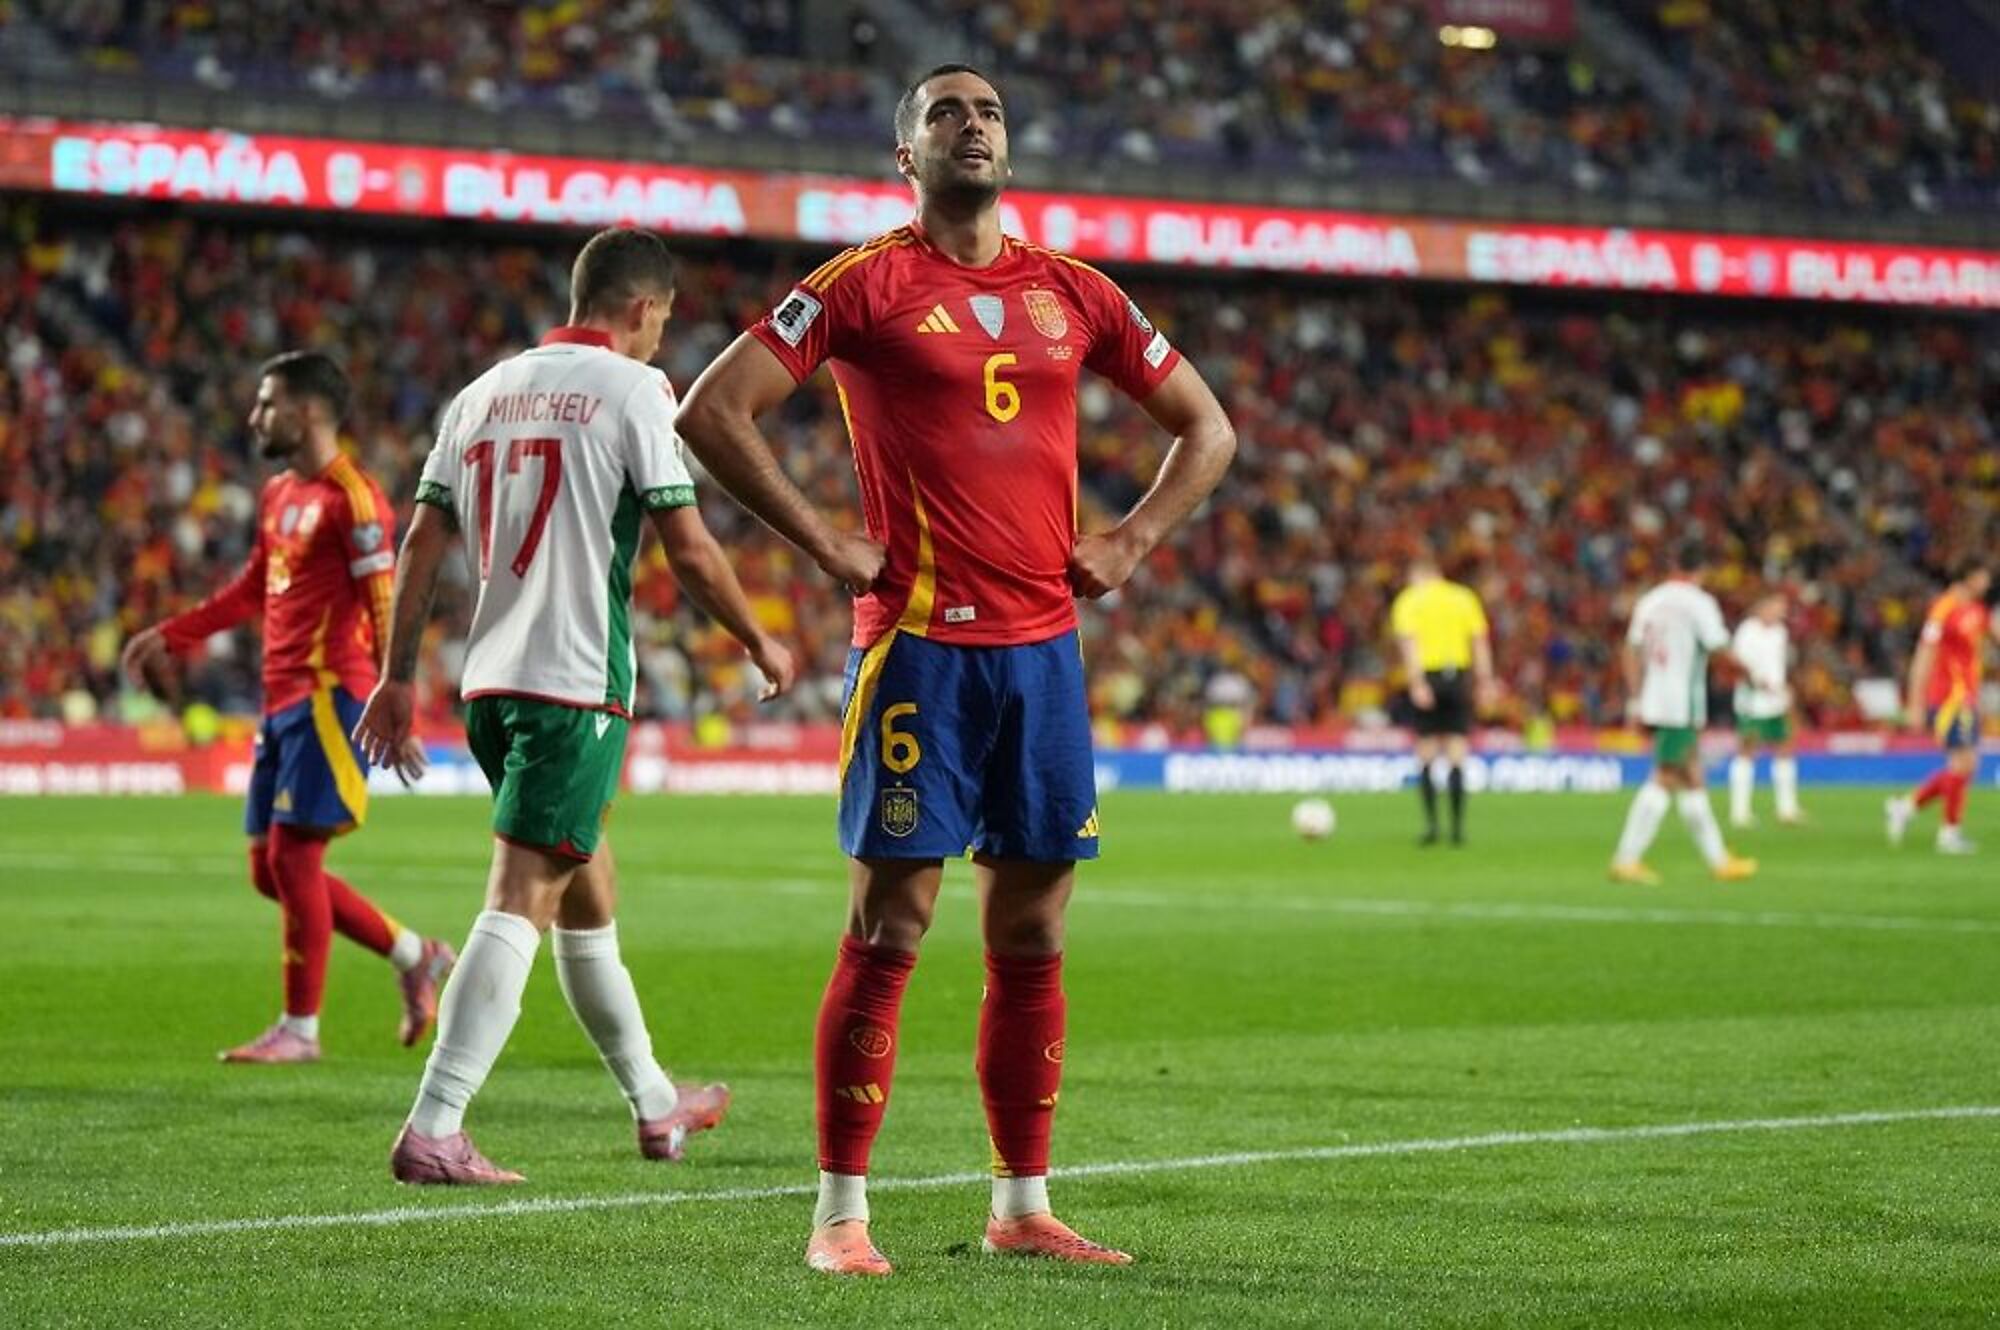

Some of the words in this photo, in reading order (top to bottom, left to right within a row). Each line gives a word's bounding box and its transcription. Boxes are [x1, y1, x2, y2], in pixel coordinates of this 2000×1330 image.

[53, 132, 309, 204] ESPAÑA
[443, 162, 746, 236] BULGARIA
[1145, 212, 1420, 275] BULGARIA
[1466, 228, 1678, 290] ESPAÑA
[486, 393, 603, 425] MINCHEV
[983, 353, 1021, 424] 6
[464, 437, 563, 580] 17
[880, 703, 921, 774] 6
